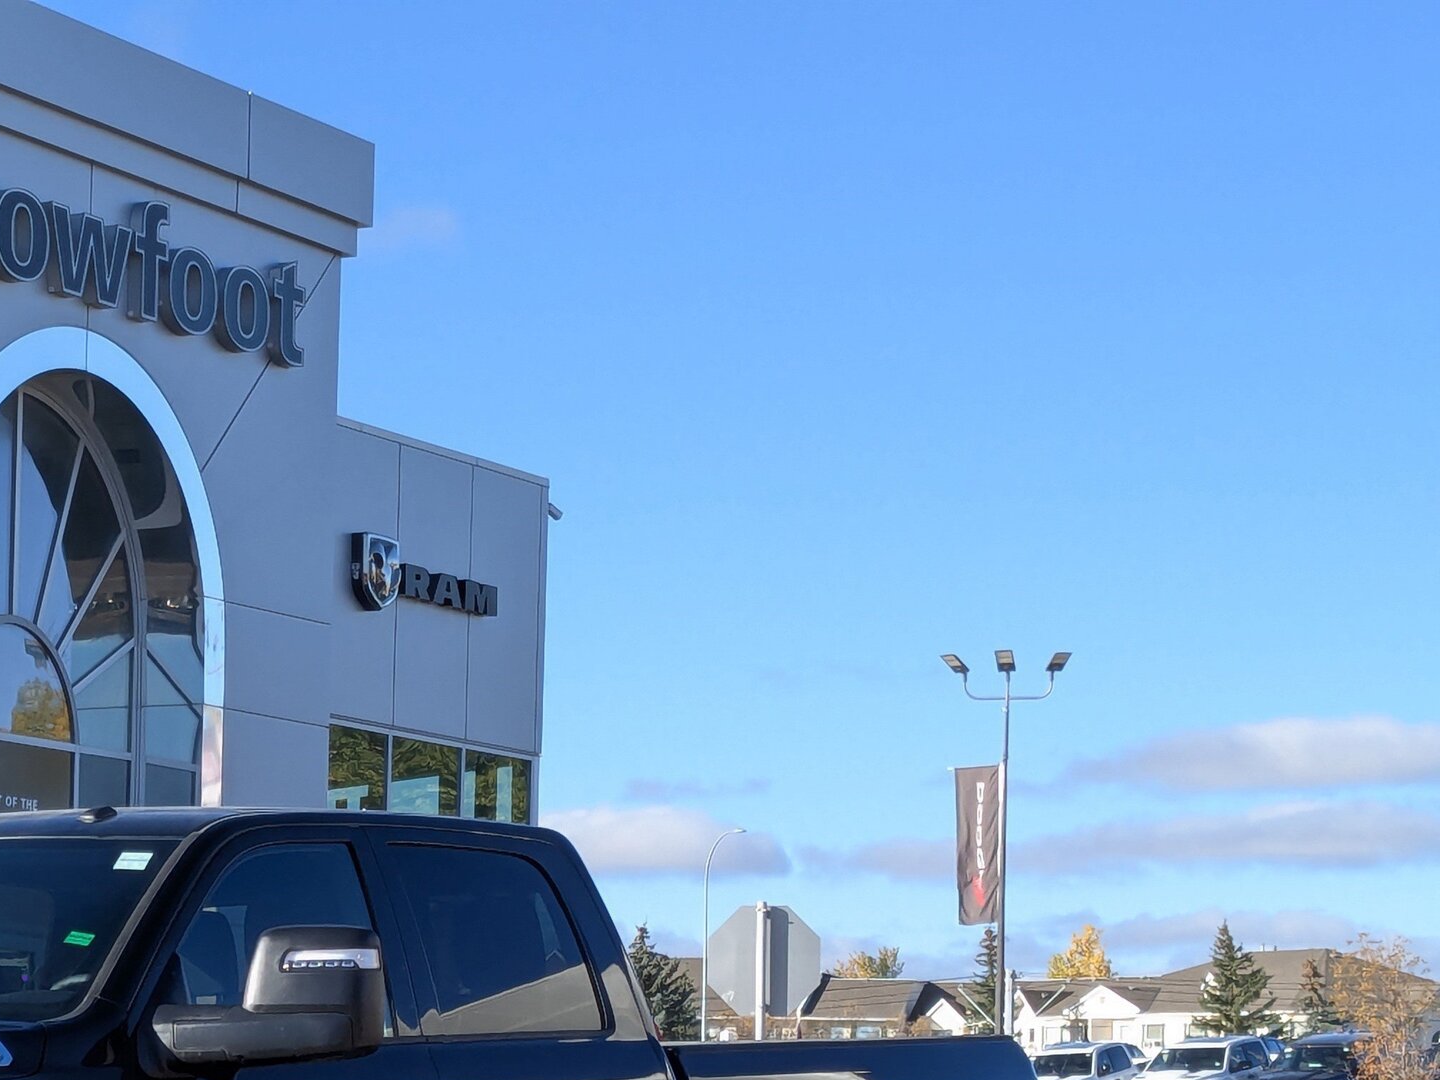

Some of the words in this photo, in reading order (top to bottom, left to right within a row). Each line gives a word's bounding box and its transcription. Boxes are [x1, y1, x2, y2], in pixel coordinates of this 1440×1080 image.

[403, 563, 498, 617] RAM
[5, 795, 18, 809] OF
[20, 798, 39, 811] THE
